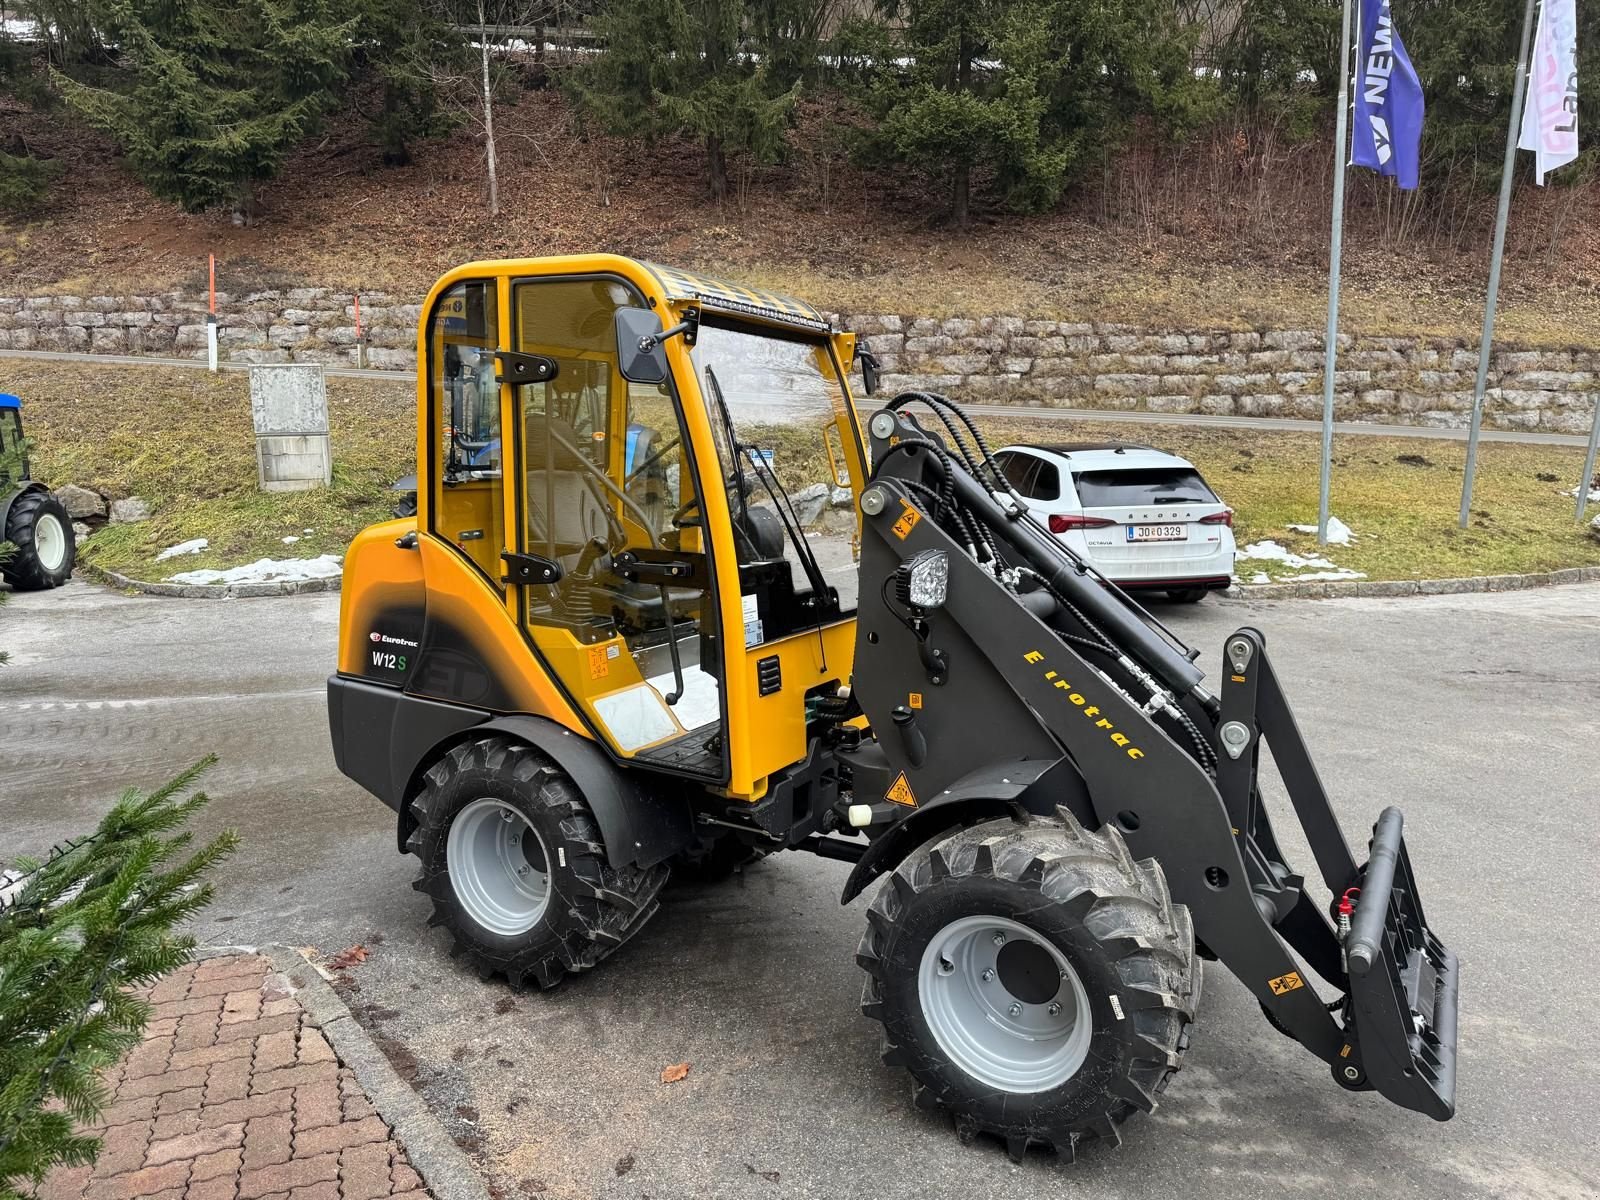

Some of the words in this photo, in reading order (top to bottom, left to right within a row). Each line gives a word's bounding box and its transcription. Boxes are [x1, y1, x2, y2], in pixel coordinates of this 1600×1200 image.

[1363, 15, 1393, 105] NEW
[1138, 527, 1150, 537] JO
[381, 634, 419, 648] Eurotrac
[372, 651, 396, 669] W12
[398, 655, 407, 671] S
